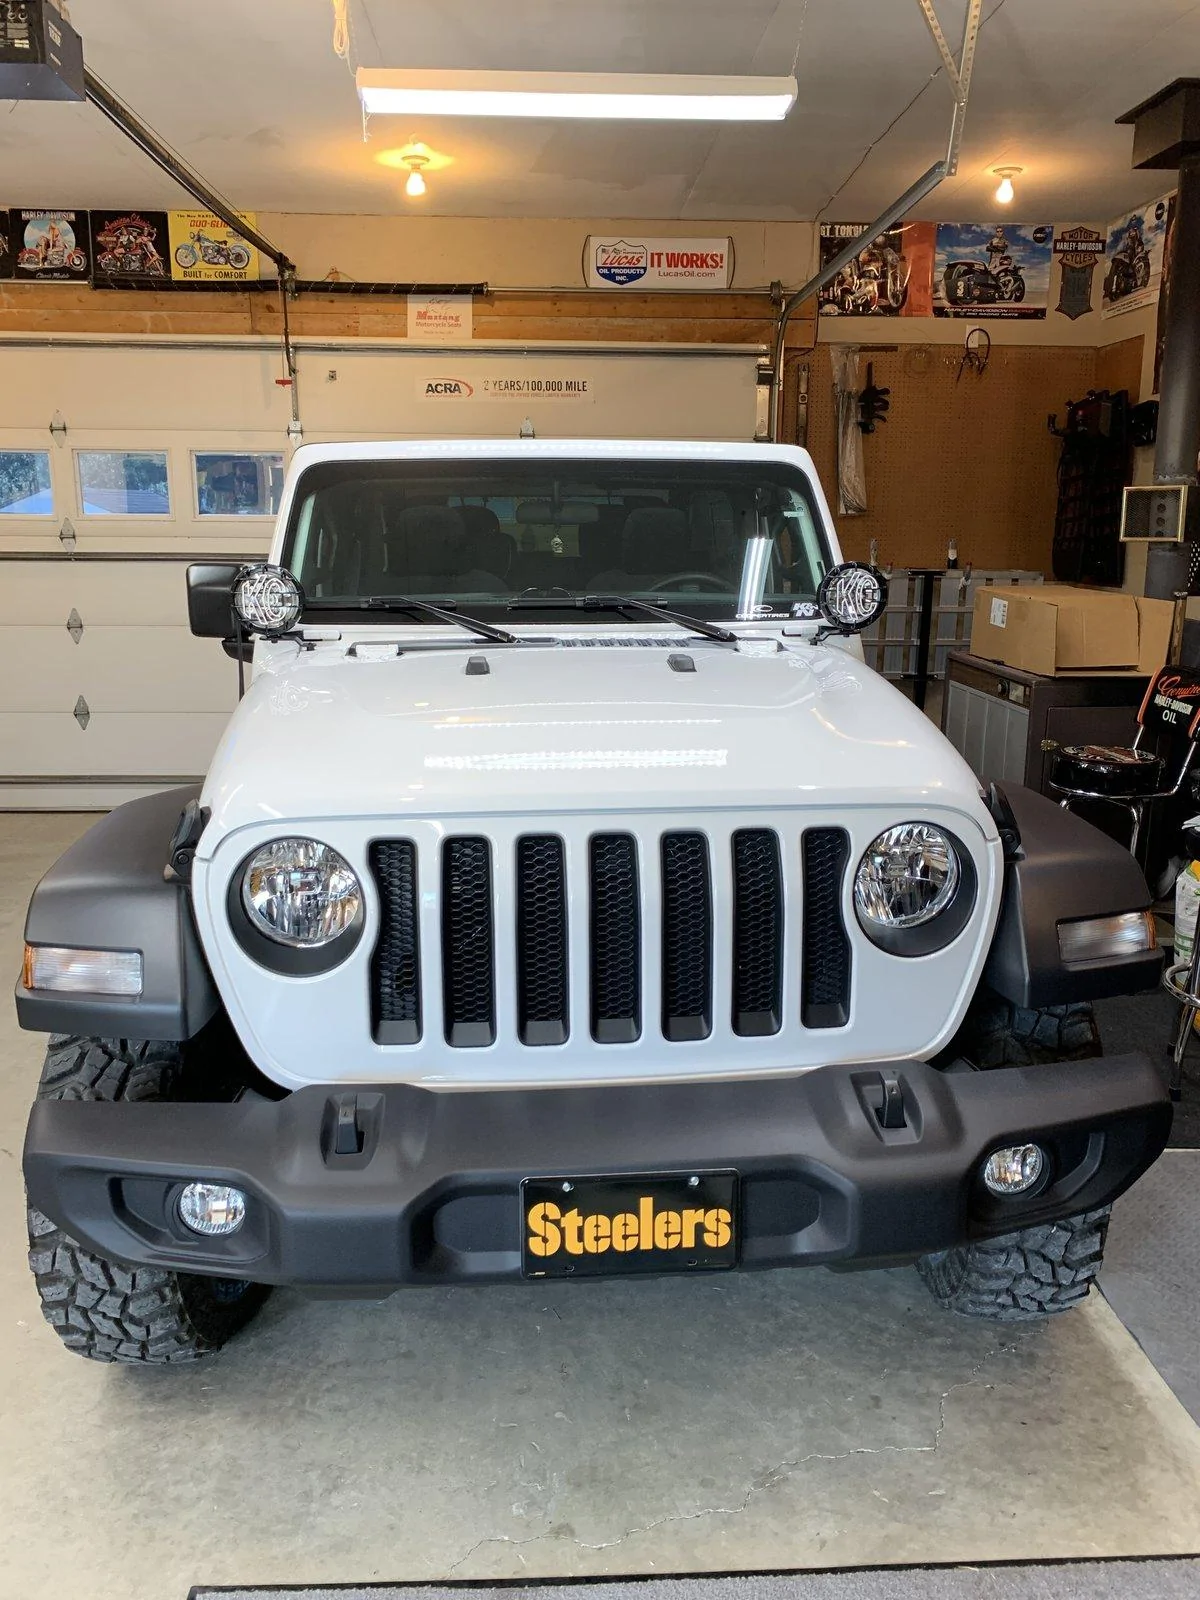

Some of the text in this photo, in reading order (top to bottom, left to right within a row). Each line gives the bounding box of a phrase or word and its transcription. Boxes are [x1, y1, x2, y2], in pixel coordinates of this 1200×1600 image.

[1069, 230, 1093, 240] MOTOR
[1056, 242, 1102, 251] HARLEY-DAVIDSON
[602, 255, 643, 266] LUCAS
[650, 253, 724, 269] IT WORKS!
[1066, 253, 1093, 264] CYCLES
[183, 270, 202, 278] BUILT
[214, 271, 248, 279] COMFORT
[425, 383, 462, 394] ACRA
[492, 380, 563, 392] YEARS/100,000
[565, 381, 587, 392] MILE
[1162, 709, 1177, 724] OIL
[528, 1197, 732, 1257] Steelers
